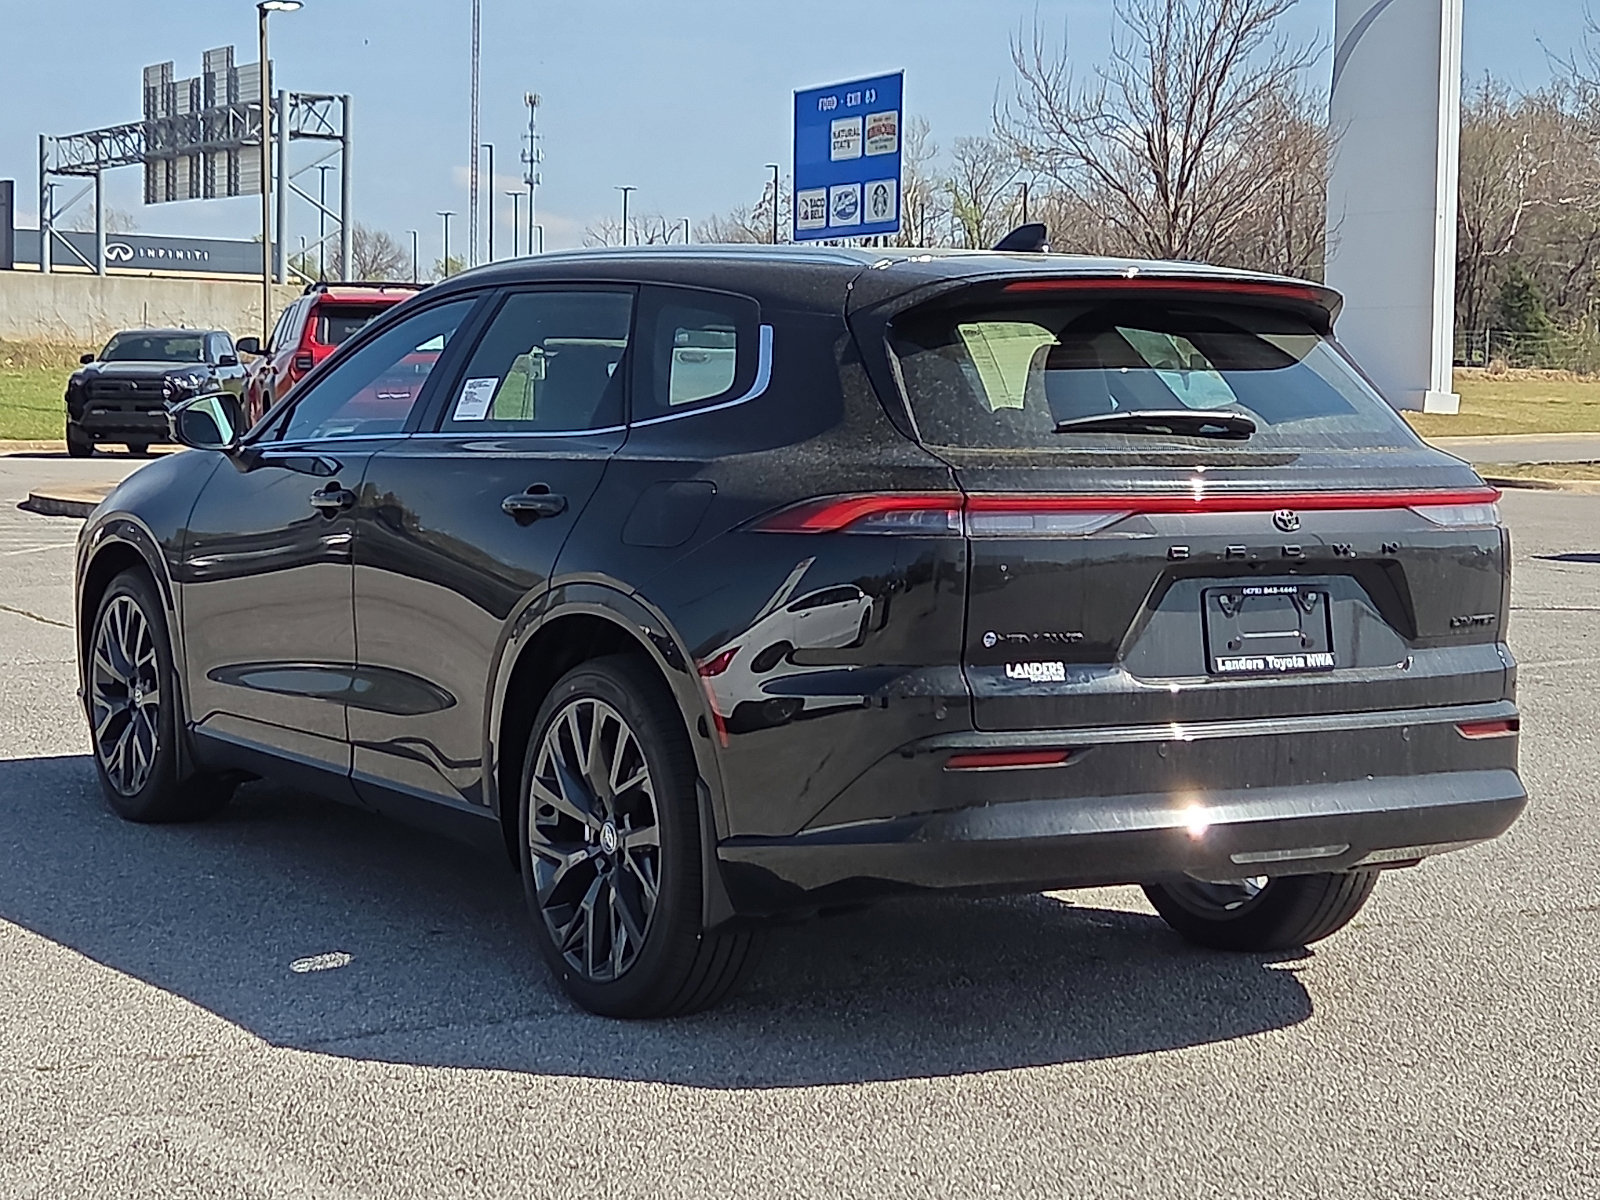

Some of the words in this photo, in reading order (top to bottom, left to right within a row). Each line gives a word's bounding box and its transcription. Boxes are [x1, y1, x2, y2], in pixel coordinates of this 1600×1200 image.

[846, 92, 862, 107] EXIT
[833, 127, 861, 139] NATURAL
[810, 197, 825, 208] TACO
[810, 209, 825, 220] BELL
[138, 247, 210, 262] INFINITI
[1216, 657, 1265, 672] Landers
[1265, 655, 1305, 672] Toyota
[1305, 652, 1335, 668] NWA
[1005, 661, 1066, 679] LANDERS
